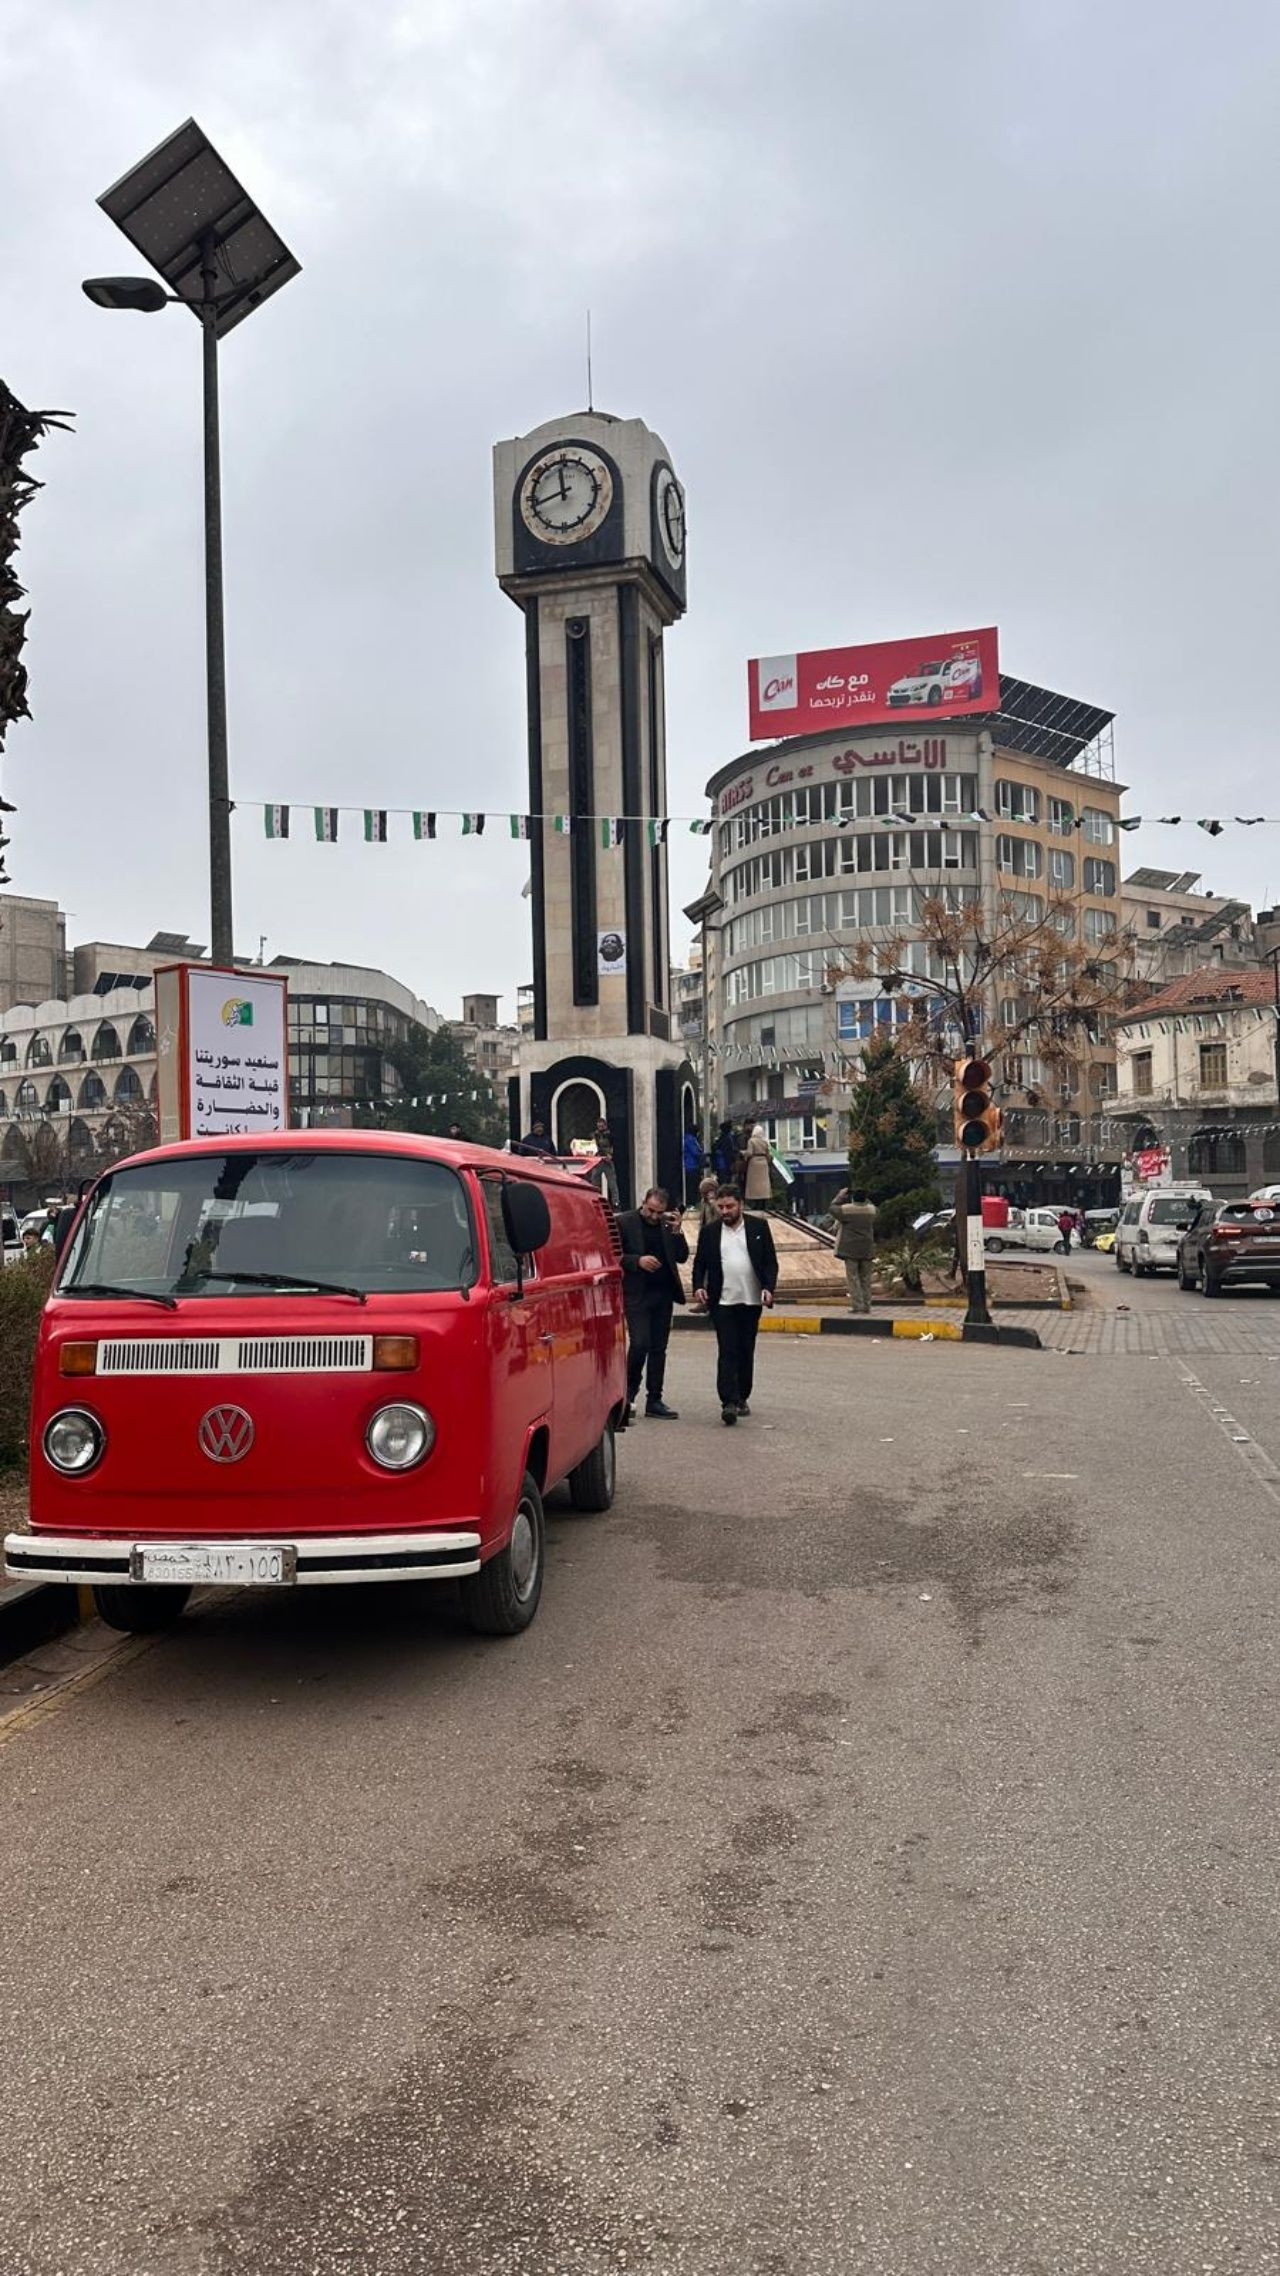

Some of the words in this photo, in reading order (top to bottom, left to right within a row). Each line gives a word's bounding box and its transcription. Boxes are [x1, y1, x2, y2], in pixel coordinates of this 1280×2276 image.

[763, 677, 793, 703] Can
[816, 674, 845, 691] كان
[847, 673, 869, 692] مع
[809, 693, 845, 709] تربحها
[195, 1049, 241, 1069] سوريتنا
[244, 1055, 279, 1072] سنعيد
[195, 1073, 245, 1090] الثقافة
[249, 1077, 279, 1096] قبلة
[197, 1096, 280, 1120] والحضارة
[147, 1553, 190, 1563] حمص
